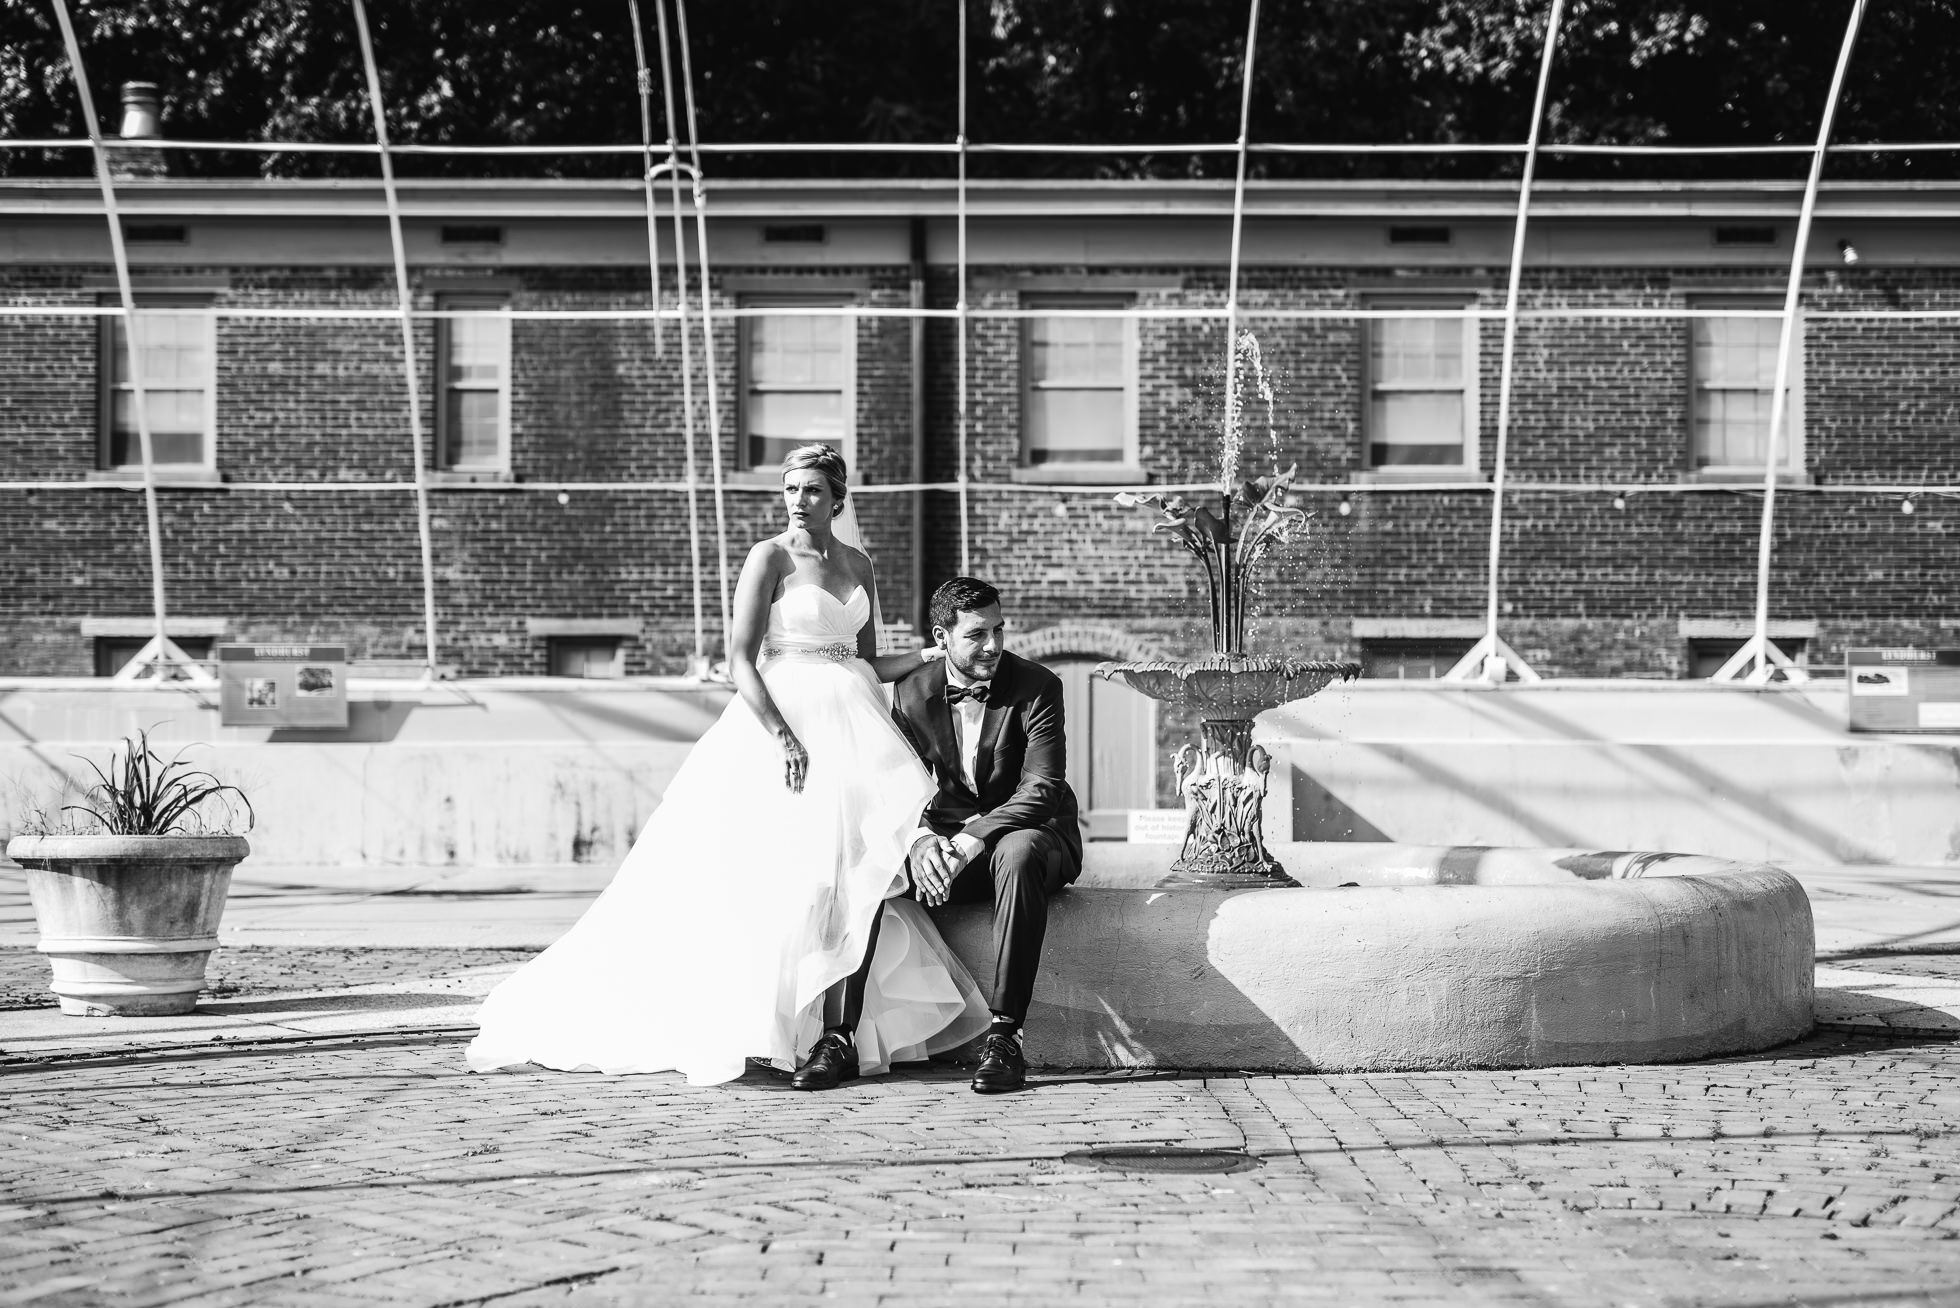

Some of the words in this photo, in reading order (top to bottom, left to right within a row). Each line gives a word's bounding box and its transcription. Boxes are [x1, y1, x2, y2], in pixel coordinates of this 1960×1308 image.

[1139, 815, 1165, 823] Please
[1150, 823, 1160, 831] of
[1145, 832, 1180, 840] fountain
